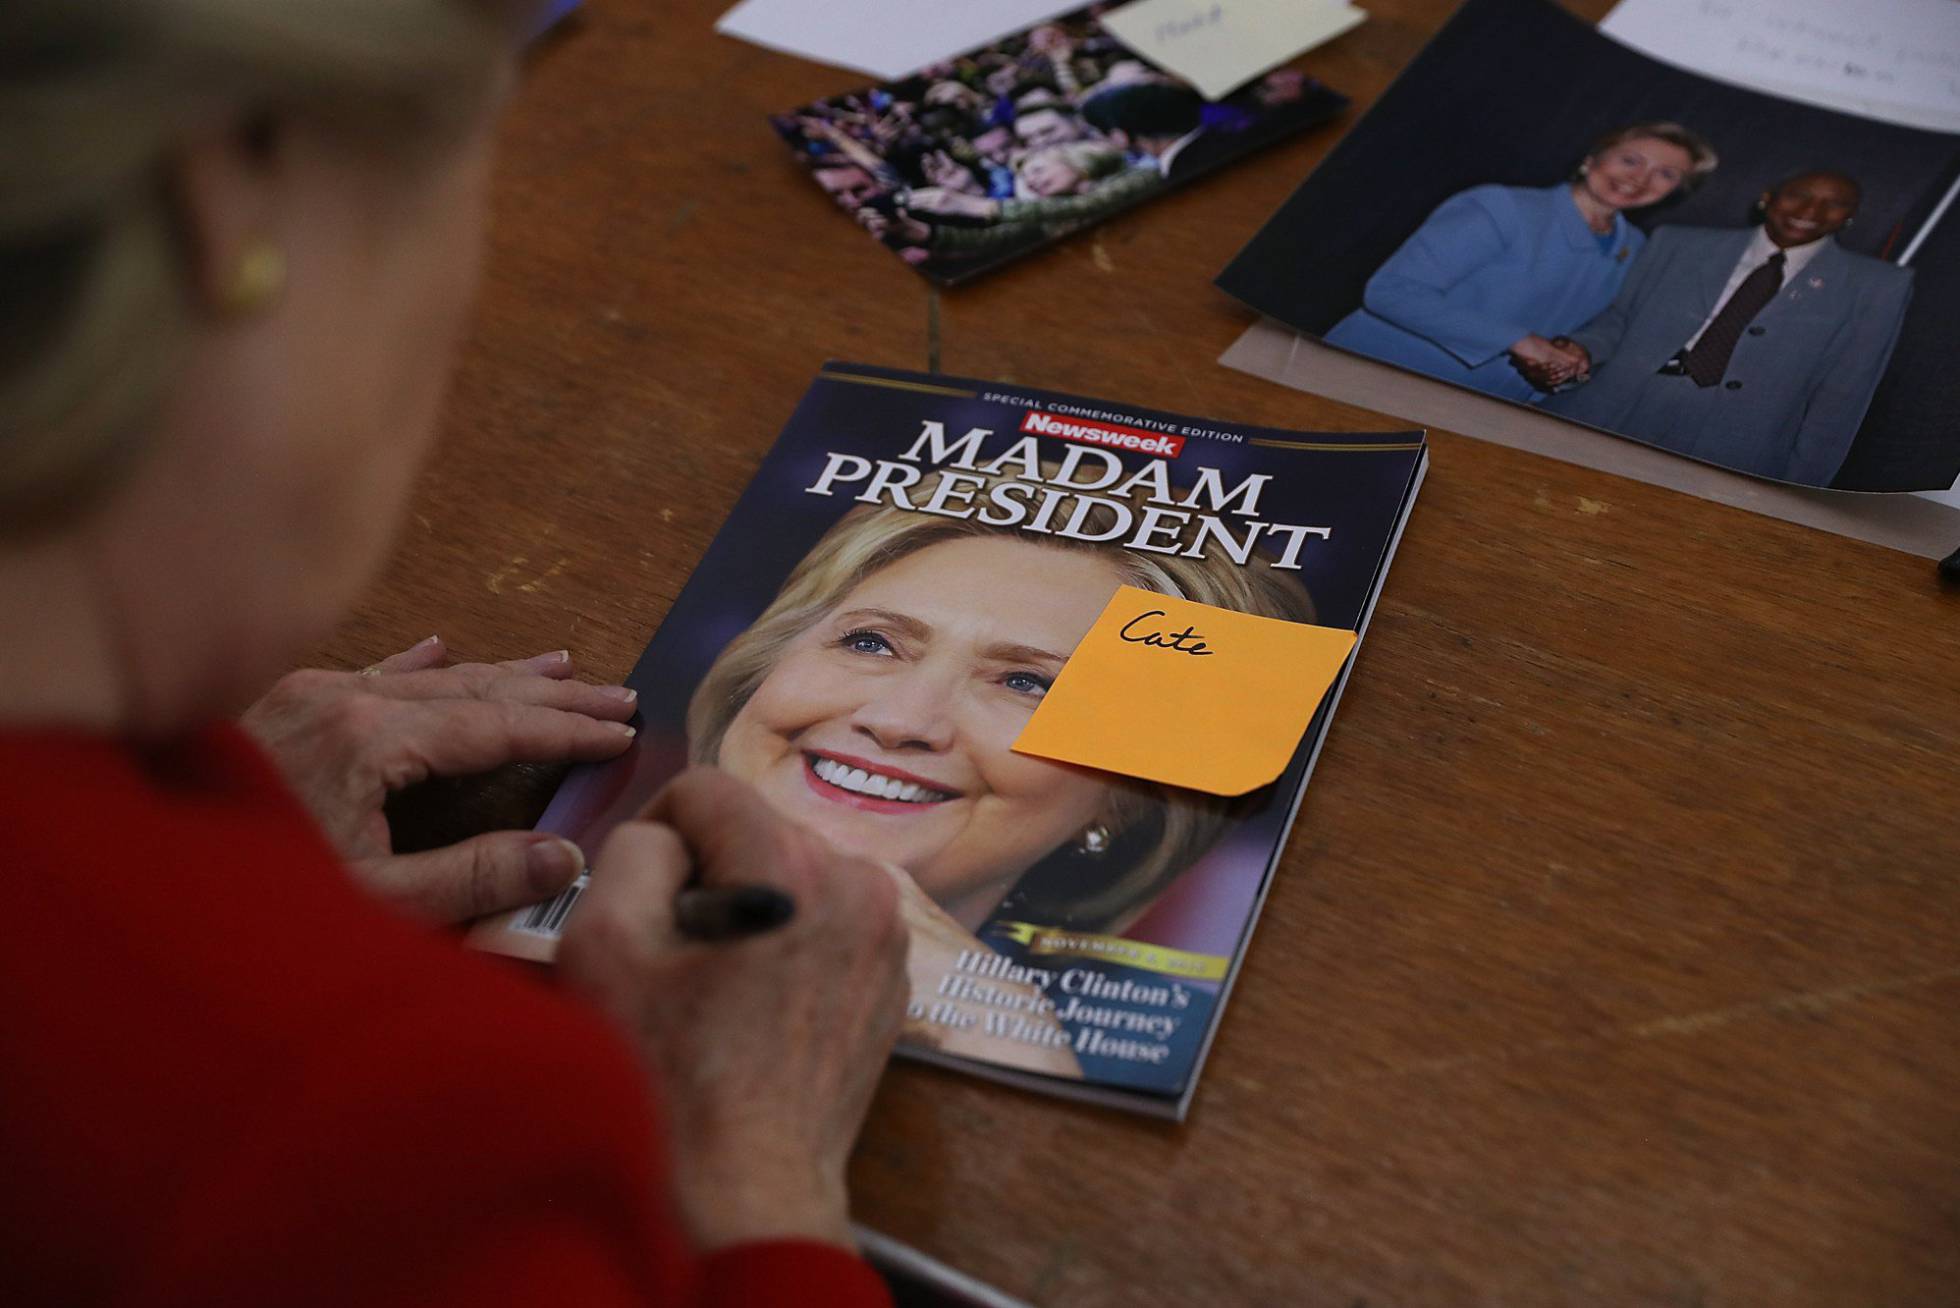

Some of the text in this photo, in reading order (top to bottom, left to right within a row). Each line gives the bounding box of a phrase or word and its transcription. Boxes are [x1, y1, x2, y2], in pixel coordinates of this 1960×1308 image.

[983, 392, 1244, 444] SPECIAL COMMEMORATIVE EDITION
[1025, 413, 1177, 455] Newsweek
[898, 420, 1273, 517] MADAM
[805, 452, 1331, 570] PRESIDENT
[1120, 610, 1214, 656] Cate
[938, 974, 1181, 1041] Historic Journey
[956, 949, 1191, 1009] Hillary Clinton's
[927, 1001, 978, 1029] the
[983, 1008, 1072, 1048] White
[1075, 1027, 1171, 1064] House
